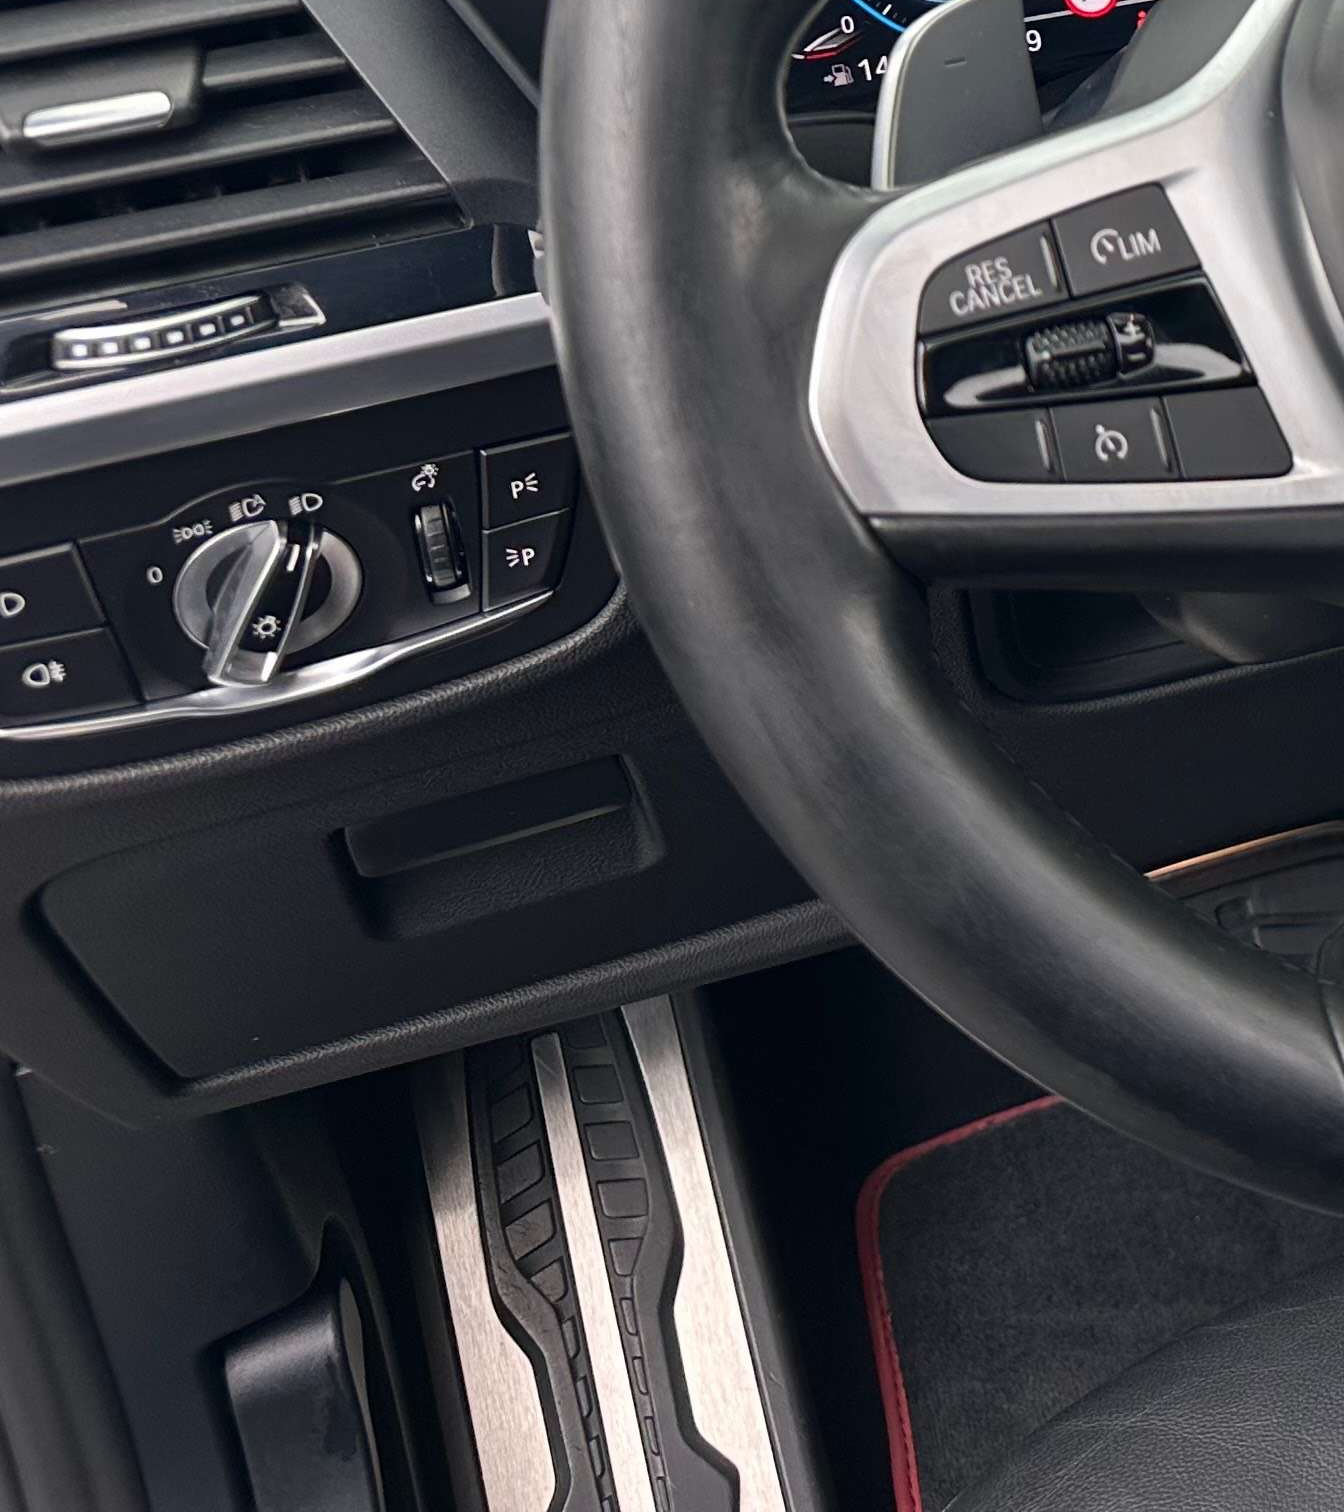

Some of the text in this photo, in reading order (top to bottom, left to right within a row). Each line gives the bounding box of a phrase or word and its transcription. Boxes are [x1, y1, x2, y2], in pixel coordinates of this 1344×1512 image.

[840, 15, 855, 36] 0
[1026, 29, 1042, 52] 9
[1118, 226, 1162, 262] LIM
[966, 256, 1013, 287] RES
[949, 274, 1042, 317] CANCEL
